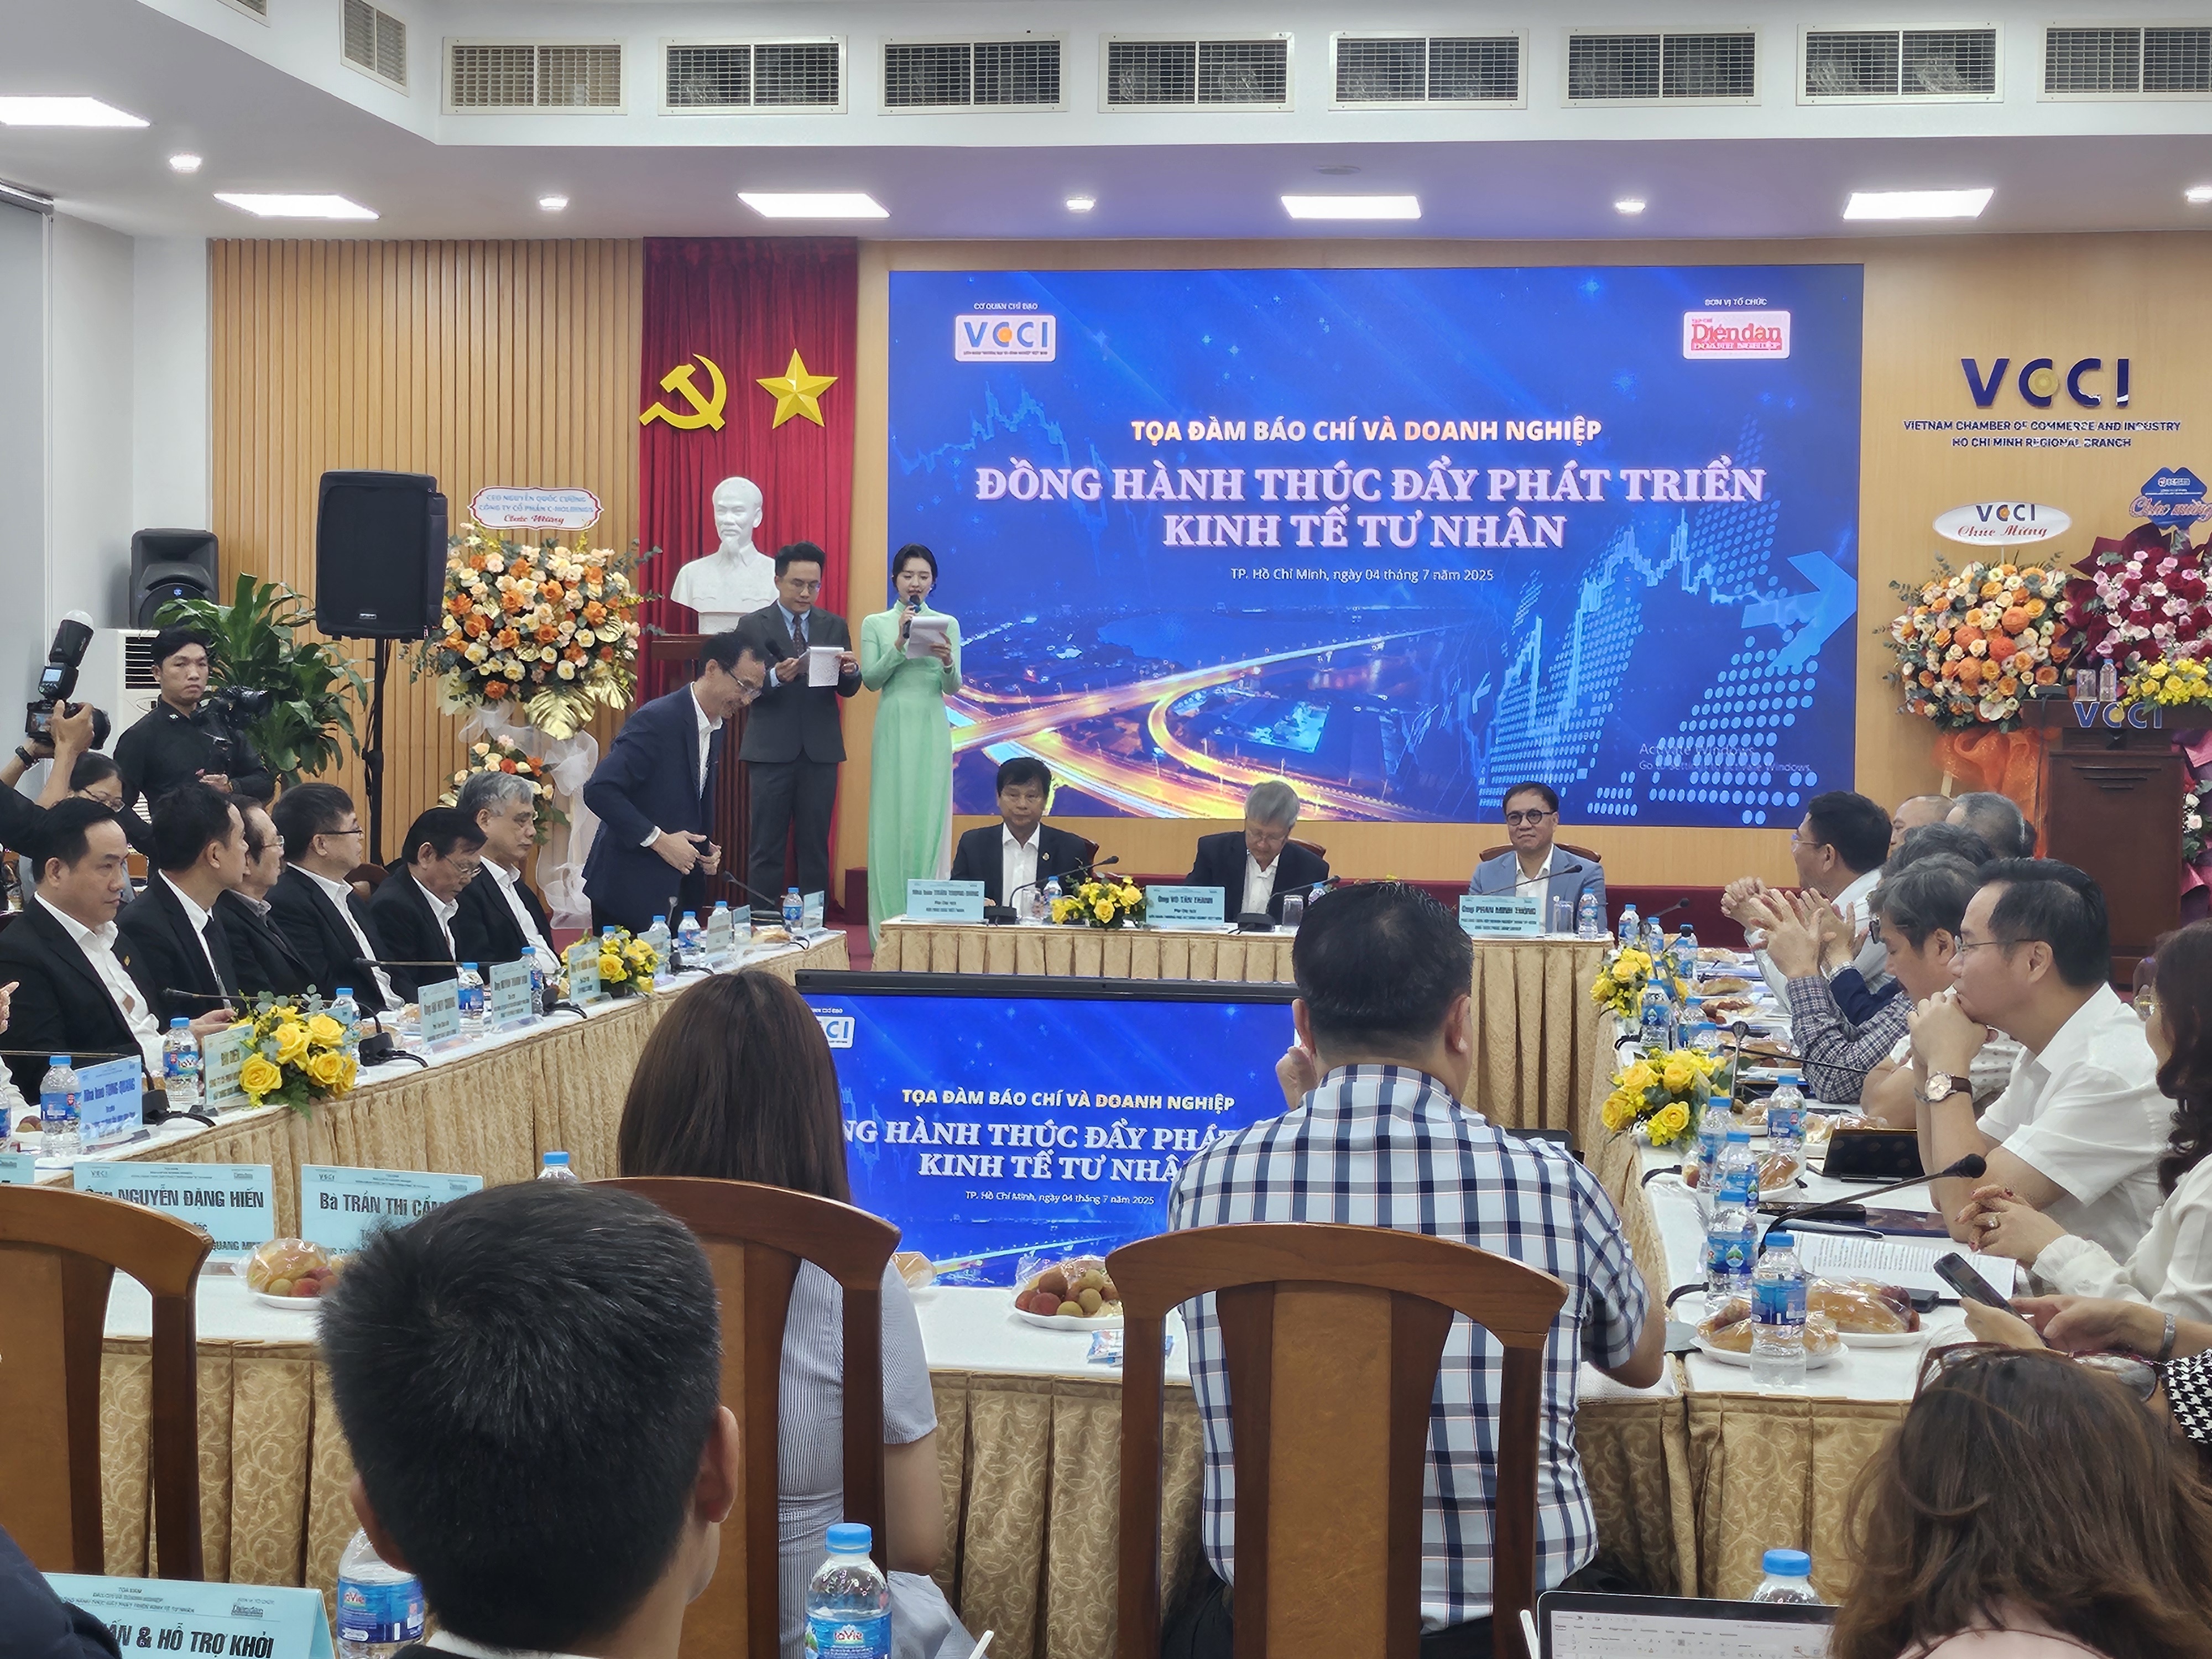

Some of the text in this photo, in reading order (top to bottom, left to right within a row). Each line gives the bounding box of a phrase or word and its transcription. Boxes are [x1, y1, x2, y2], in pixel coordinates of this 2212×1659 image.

[964, 322, 1047, 348] VCCI
[1961, 358, 2129, 408] VCCI
[1131, 415, 1602, 446] TỌA ĐÀM BÁO CHÍ VÀ DOANH NGHIỆP
[1903, 420, 2182, 431] VIETNAM CHAMBER OF COMMERCE AND INDUSTRY
[1952, 437, 2132, 448] HO CHI MINH REGIONAL BRANCH
[975, 454, 1767, 502] ĐỒNG HÀNH THÚC ĐẨY PHÁT TRIỂN
[1162, 503, 1567, 549] KINH TẾ TƯ NHÂN
[1976, 504, 2036, 522] VCCI
[1230, 568, 1249, 581] TP.
[1253, 567, 1270, 581] Hồ
[1296, 568, 1329, 582] Minh,
[1333, 568, 1363, 583] ngày
[1365, 569, 1380, 581] 04
[1384, 568, 1419, 583] tháng
[1422, 569, 1430, 581] 7
[1432, 569, 1461, 581] năm
[1464, 569, 1494, 581] 2025
[2073, 701, 2162, 729] VCCI
[819, 1021, 849, 1039] CI
[902, 1087, 1235, 1115] TỌA ĐÀM BÁO CHÍ VÀ DOANH NGHIỆP
[843, 1115, 1238, 1151] NG HÀNH THÚC ĐẨY PHÁ
[918, 1149, 1180, 1182] KINH TẾ TƯ NHÂ
[118, 1183, 179, 1206] NGUYỄN
[183, 1187, 226, 1209] ĐẶNG
[320, 1192, 338, 1211] Bà
[1133, 1196, 1155, 1205] 2025
[110, 1619, 133, 1646] ẤN
[136, 1626, 152, 1648] &
[157, 1623, 184, 1651] HỖ
[191, 1631, 228, 1658] TRỢ
